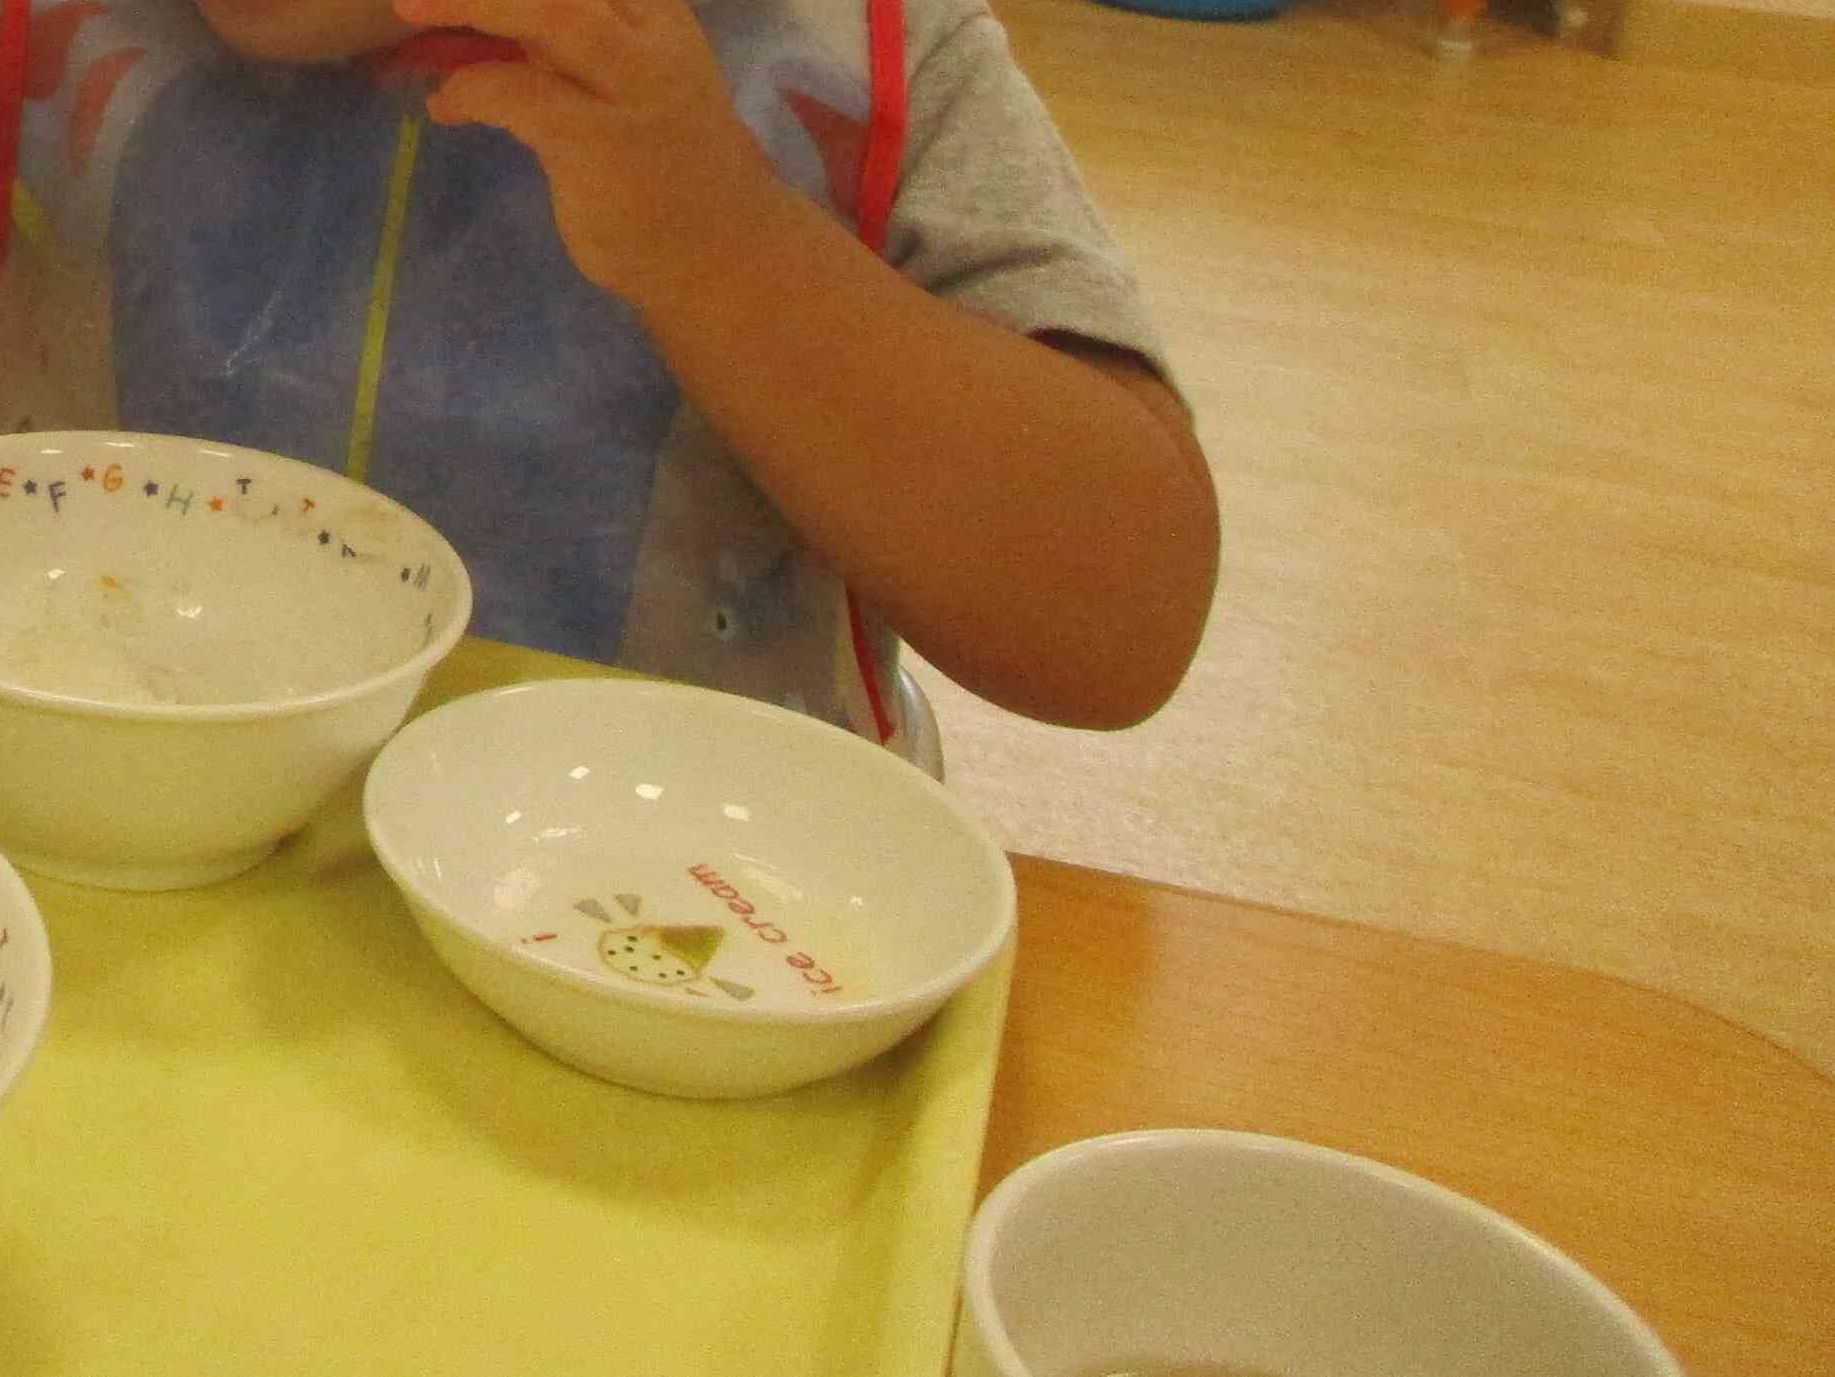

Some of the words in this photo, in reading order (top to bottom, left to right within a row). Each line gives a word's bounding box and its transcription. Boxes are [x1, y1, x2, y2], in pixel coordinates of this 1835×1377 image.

[48, 480, 68, 514] F
[102, 462, 125, 493] G
[165, 483, 196, 517] H
